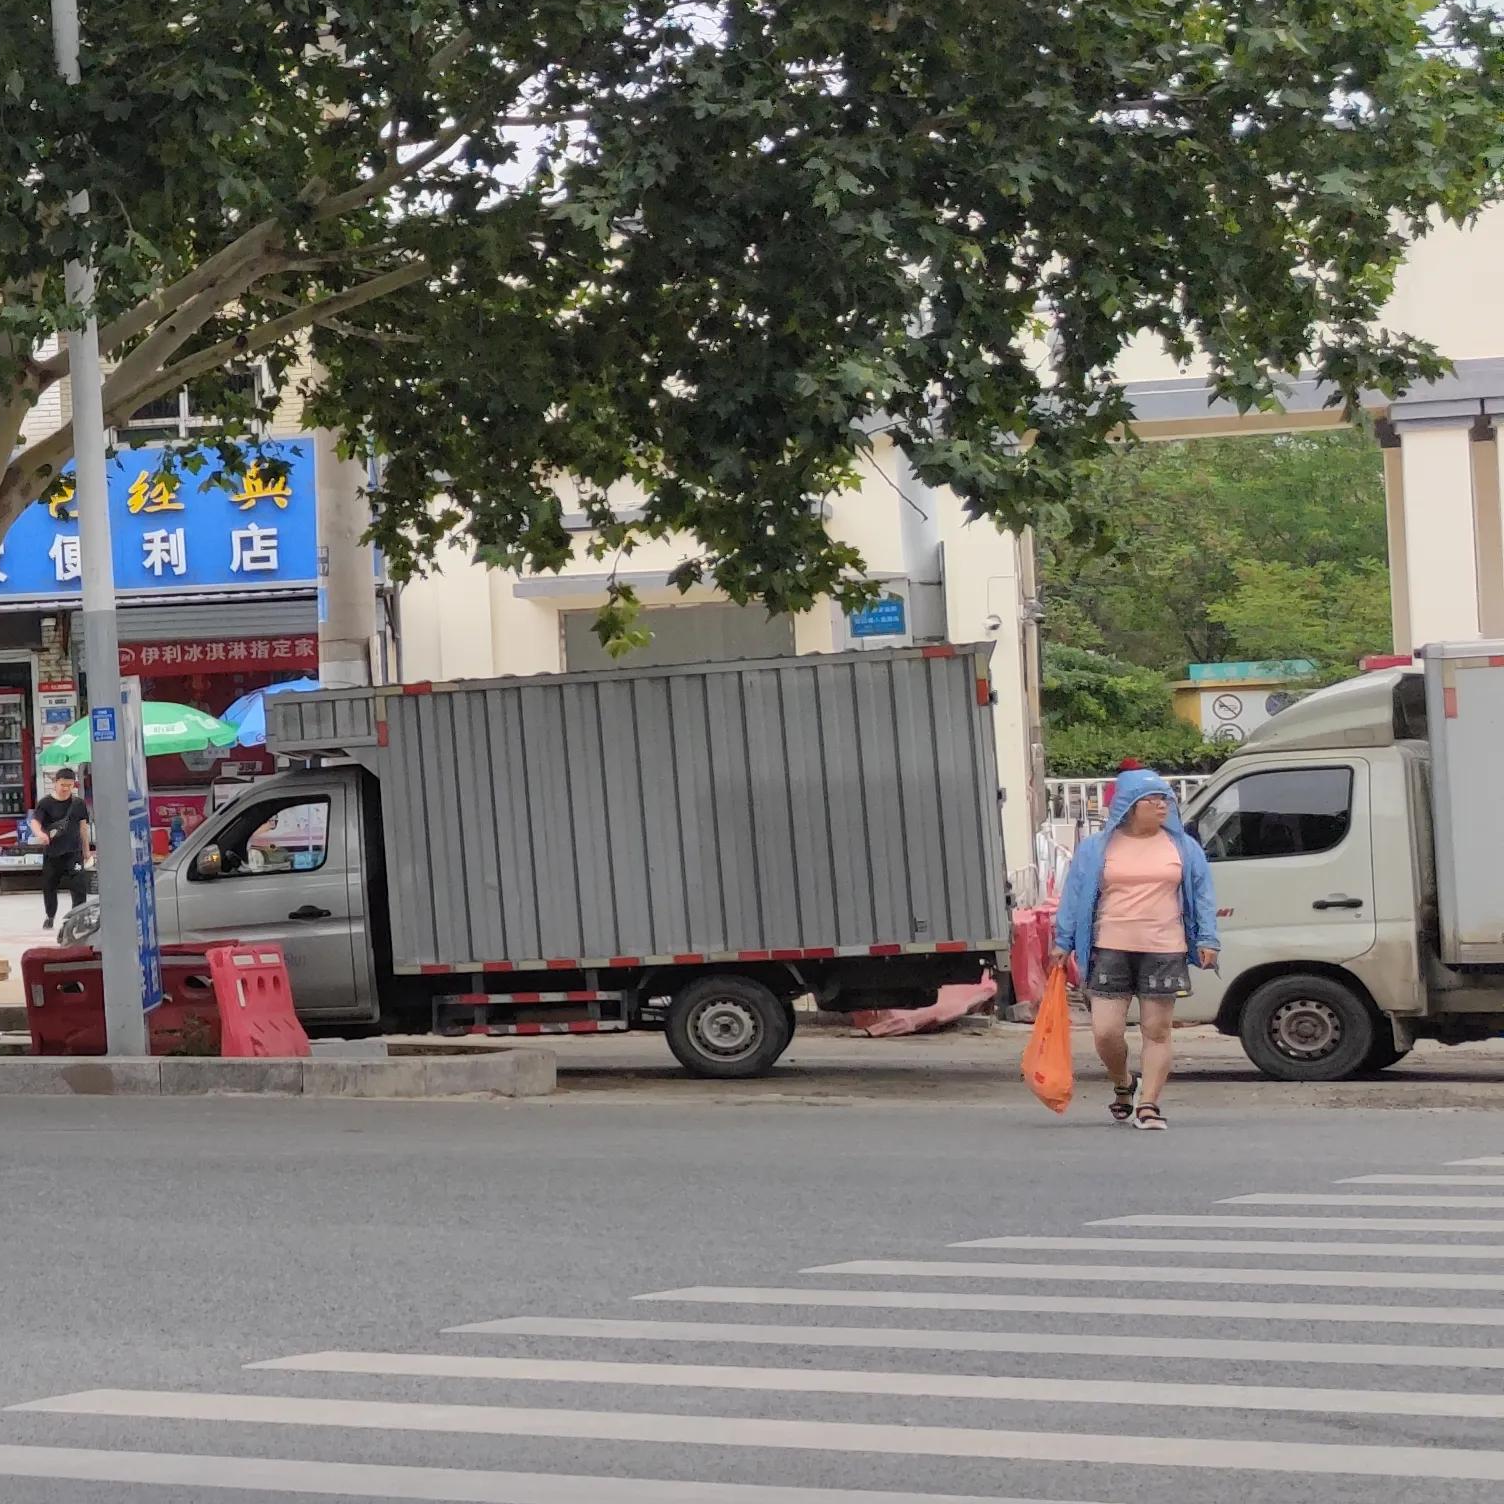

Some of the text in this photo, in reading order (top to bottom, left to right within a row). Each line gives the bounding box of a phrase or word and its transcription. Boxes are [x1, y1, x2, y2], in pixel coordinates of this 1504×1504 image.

[140, 639, 315, 666] 伊利冰淇淋指定家
